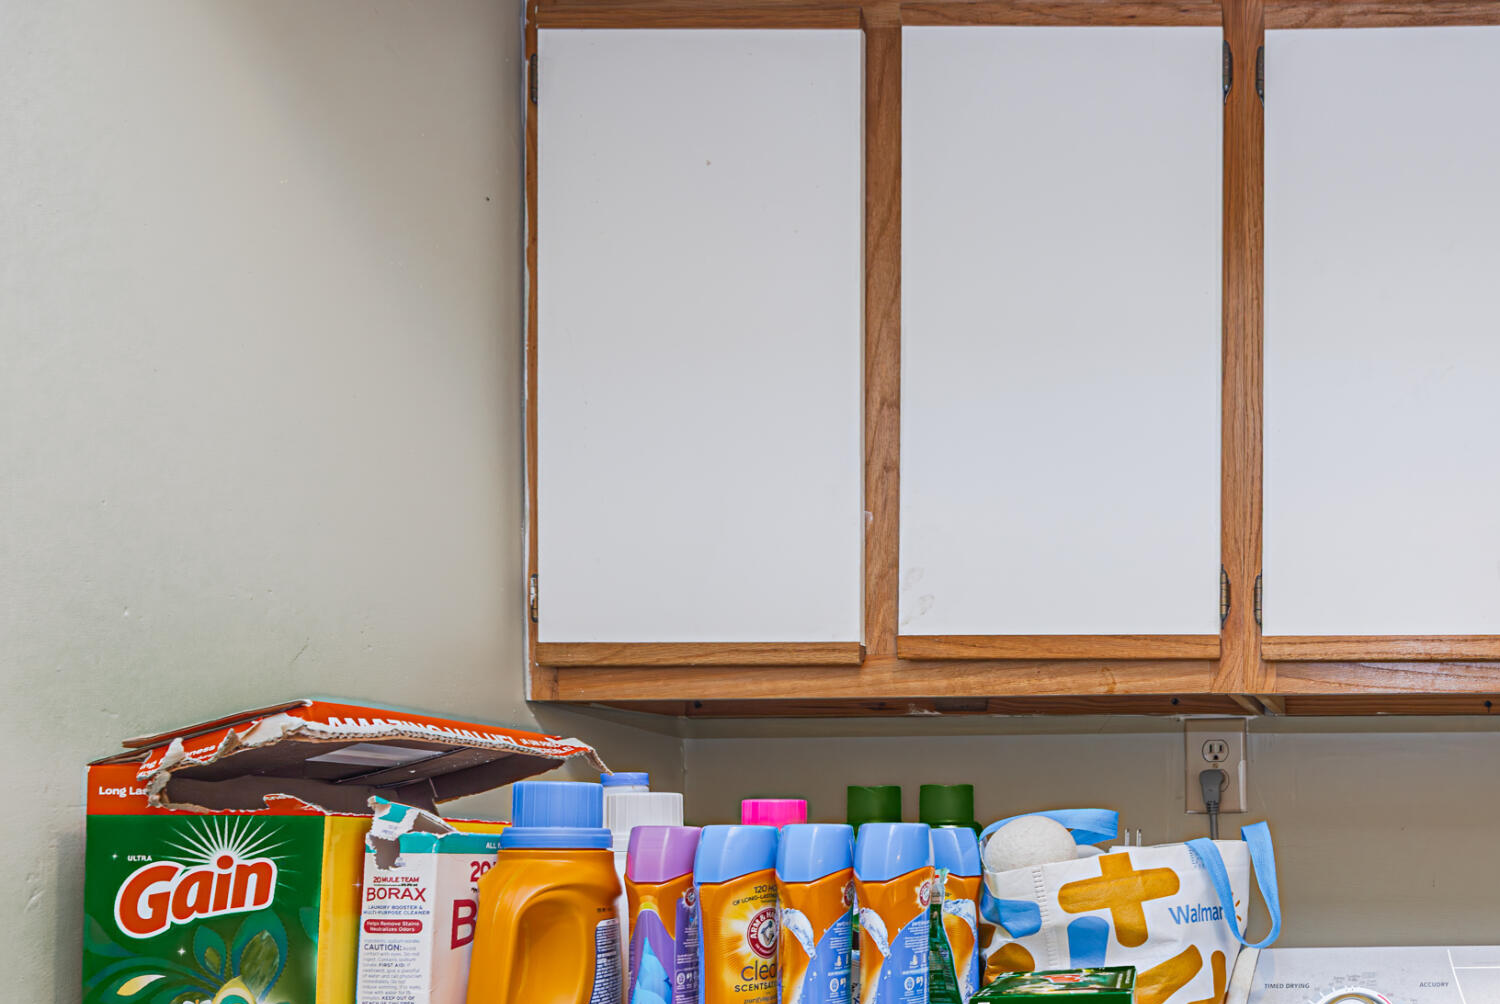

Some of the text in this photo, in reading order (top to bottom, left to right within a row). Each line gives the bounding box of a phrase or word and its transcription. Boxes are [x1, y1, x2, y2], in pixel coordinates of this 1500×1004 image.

[98, 786, 127, 798] Long
[117, 853, 276, 937] Gain
[366, 887, 426, 902] BORAX
[1168, 903, 1224, 925] Walmar
[740, 960, 777, 982] clea
